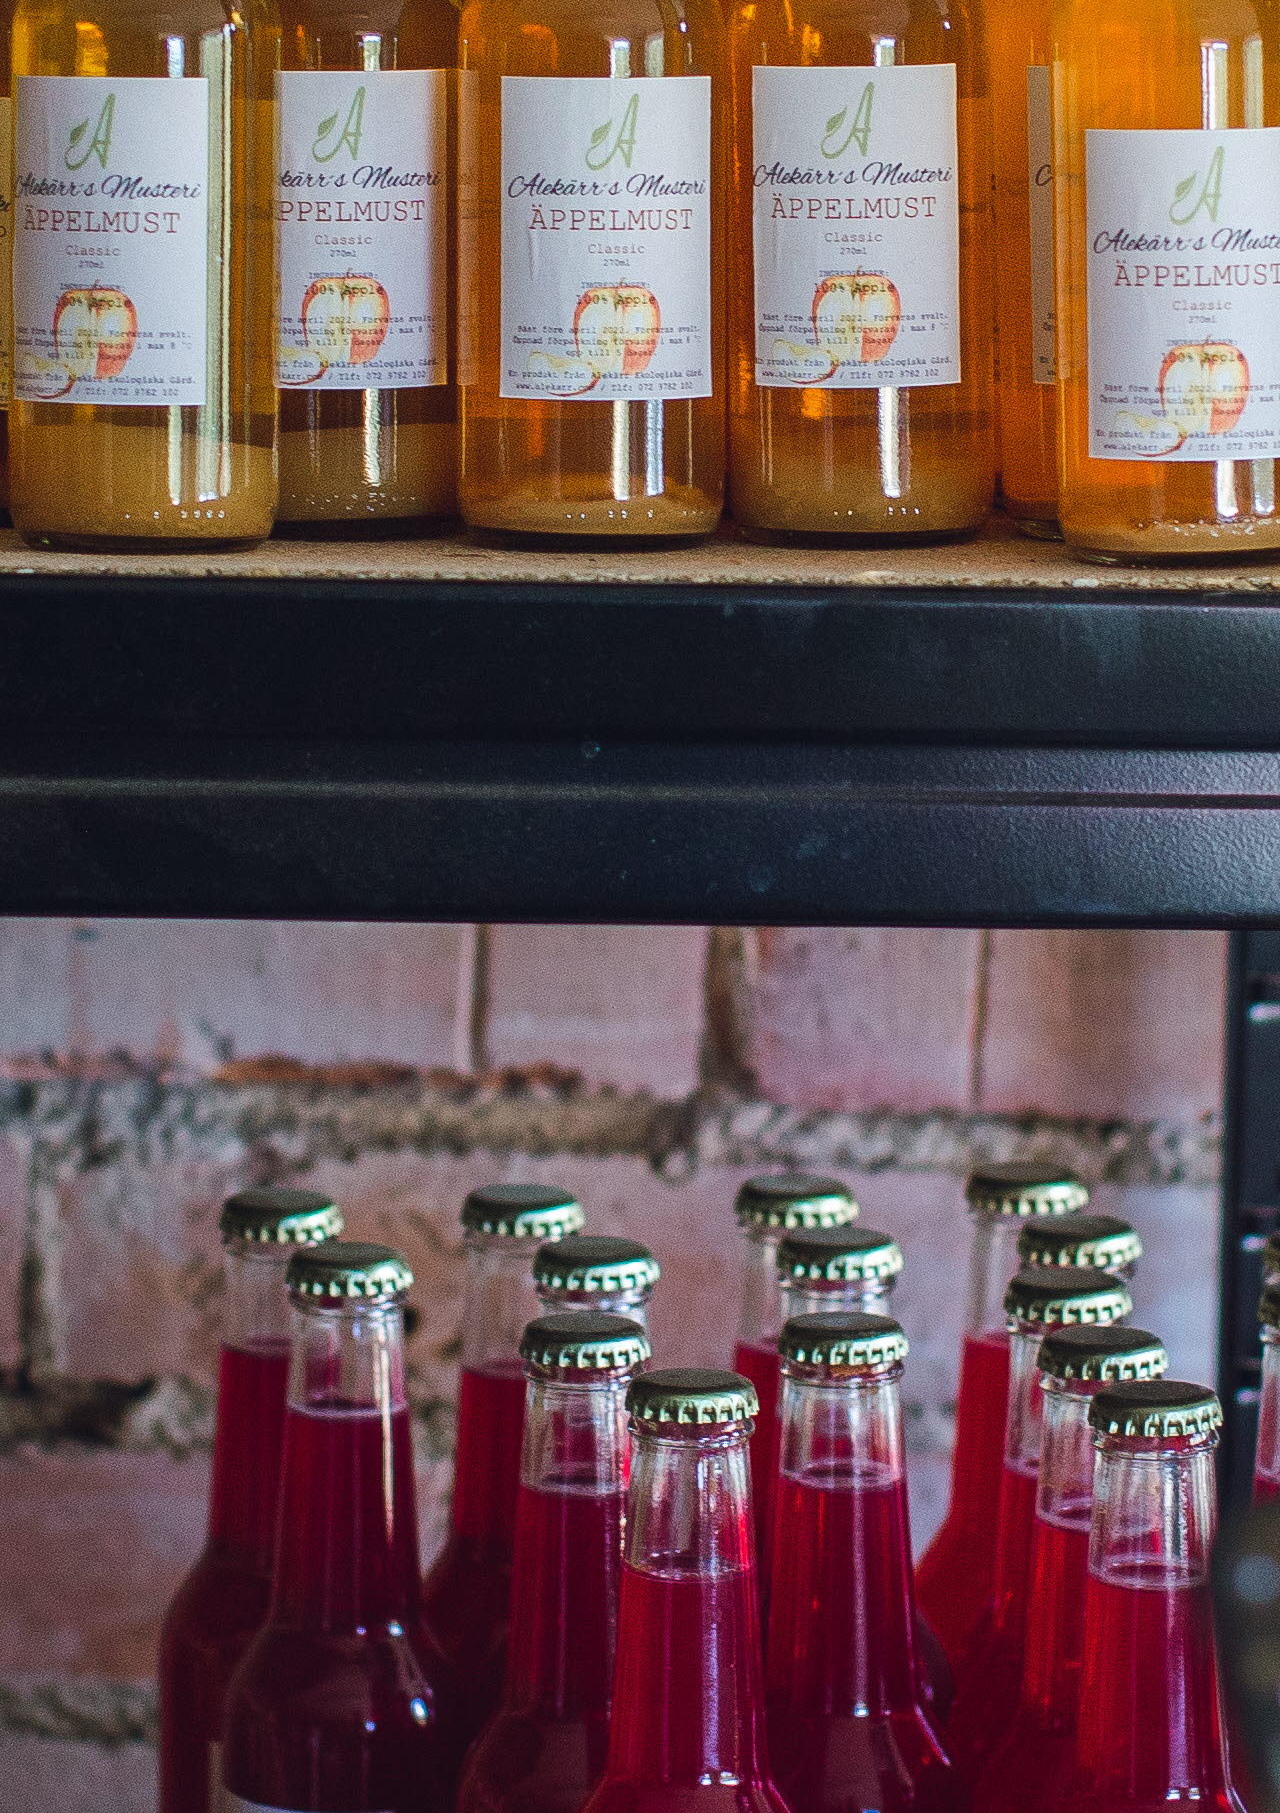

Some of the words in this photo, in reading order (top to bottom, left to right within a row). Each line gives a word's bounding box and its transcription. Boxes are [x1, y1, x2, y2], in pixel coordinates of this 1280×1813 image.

[280, 170, 348, 189] kärr's
[352, 165, 441, 189] Musteri
[626, 173, 707, 198] Musteri
[863, 161, 953, 186] Musteri
[101, 174, 200, 200] Musteri
[278, 200, 426, 222] PPELMUST
[528, 203, 694, 231] ÄPPELMUST
[771, 193, 937, 220] ÄPPELMUST
[24, 206, 180, 234] ÄPPELMUST
[315, 234, 373, 246] Classic
[587, 243, 645, 255] Classic
[824, 231, 883, 243] Classic
[65, 245, 120, 256] Classic
[1173, 299, 1232, 312] Classic
